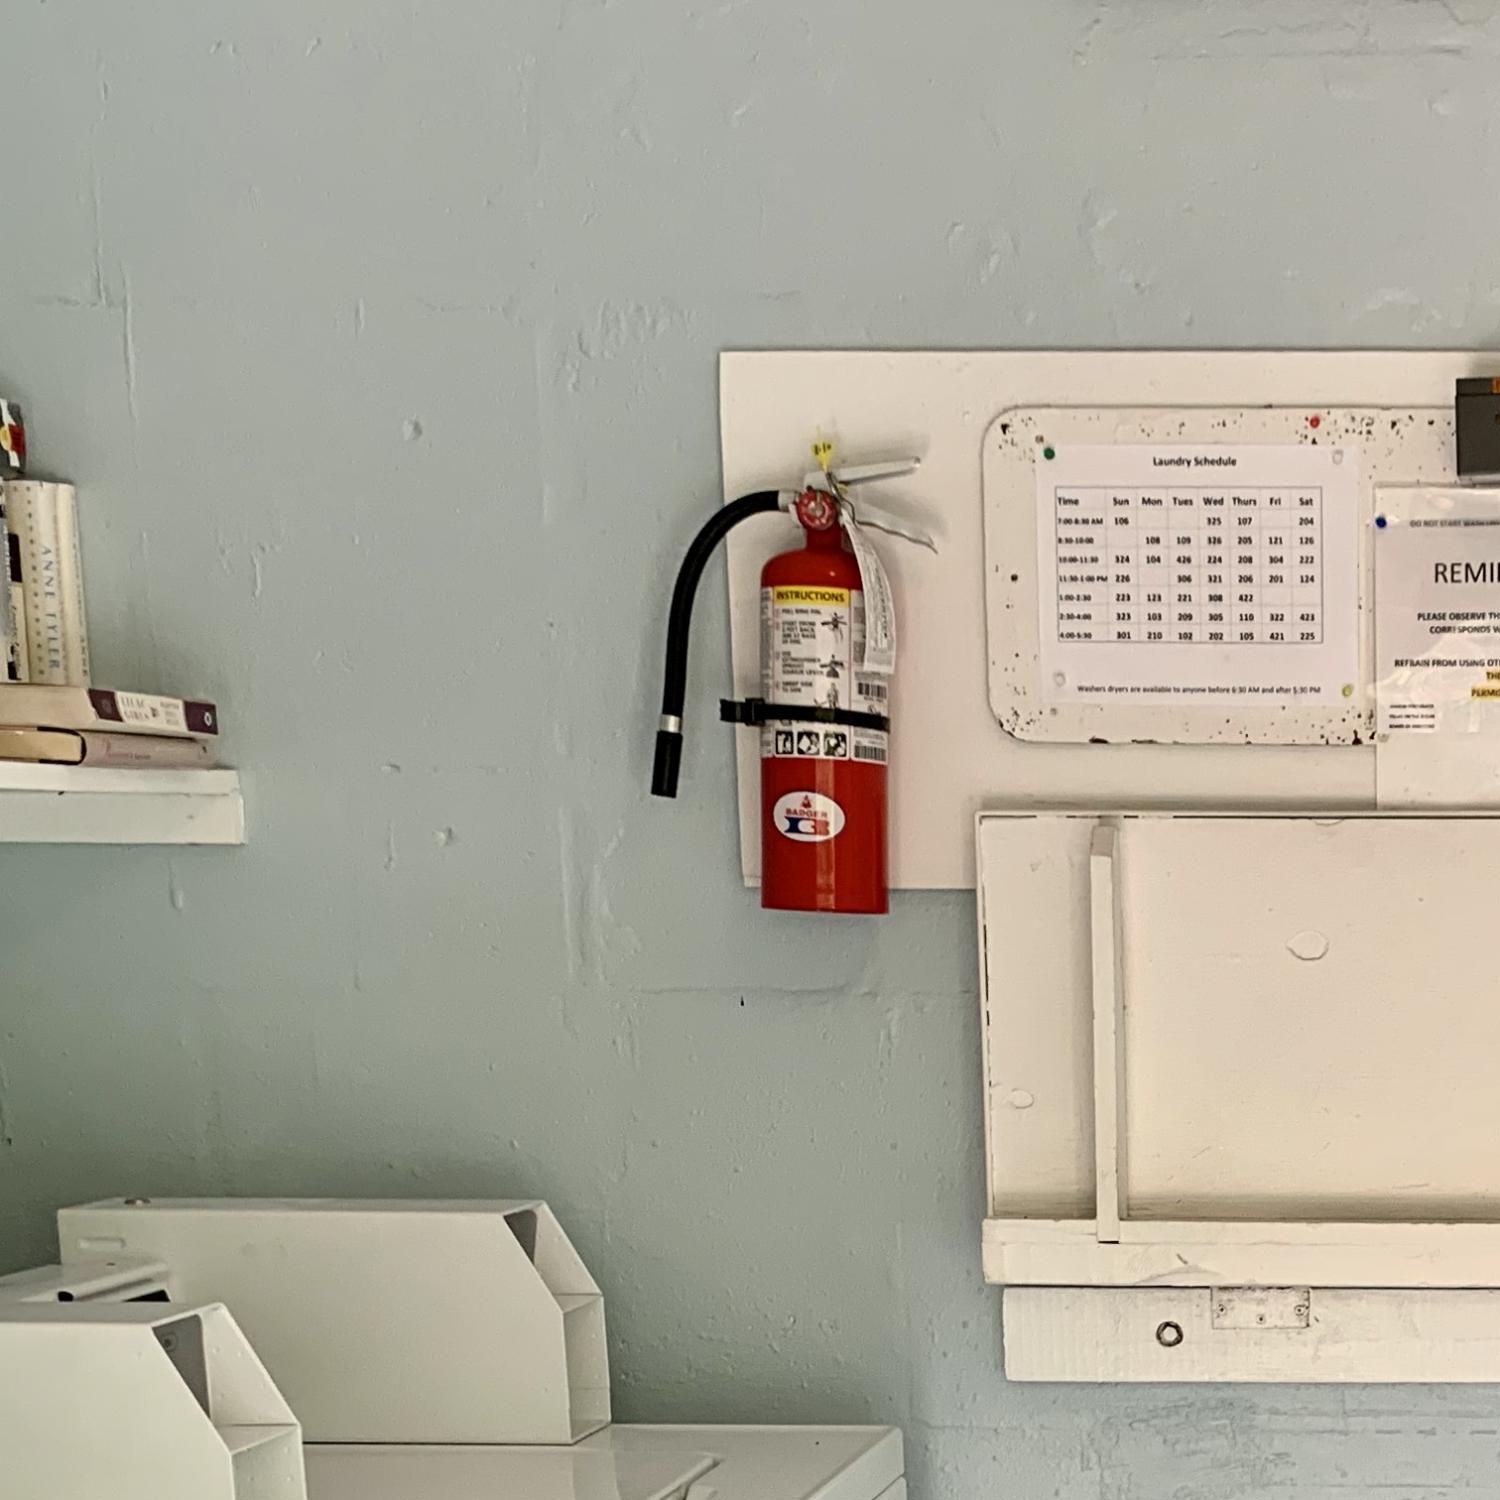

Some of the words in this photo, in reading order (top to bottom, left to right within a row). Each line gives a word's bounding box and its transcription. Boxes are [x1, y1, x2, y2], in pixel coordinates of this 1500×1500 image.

[1153, 457, 1191, 467] Laundry
[1194, 457, 1236, 466] Schedule
[1058, 497, 1079, 506] Time
[1113, 497, 1129, 506] Sun
[1142, 497, 1162, 505] Mon
[1173, 497, 1193, 506] Tues
[1203, 497, 1224, 506] Wed
[1232, 497, 1256, 506] Thurs
[1270, 497, 1281, 505] Fri
[1299, 497, 1313, 506] Sat
[1115, 517, 1129, 525] 106
[42, 548, 55, 597] ANNE
[776, 590, 844, 602] INSTRUCTIONS
[1417, 613, 1446, 621] PLEASE
[1449, 612, 1486, 620] OBSERVE
[46, 614, 60, 668] TYLER
[1394, 659, 1430, 667] REFRAIN
[1432, 659, 1457, 667] FROM
[1459, 659, 1485, 667] USING
